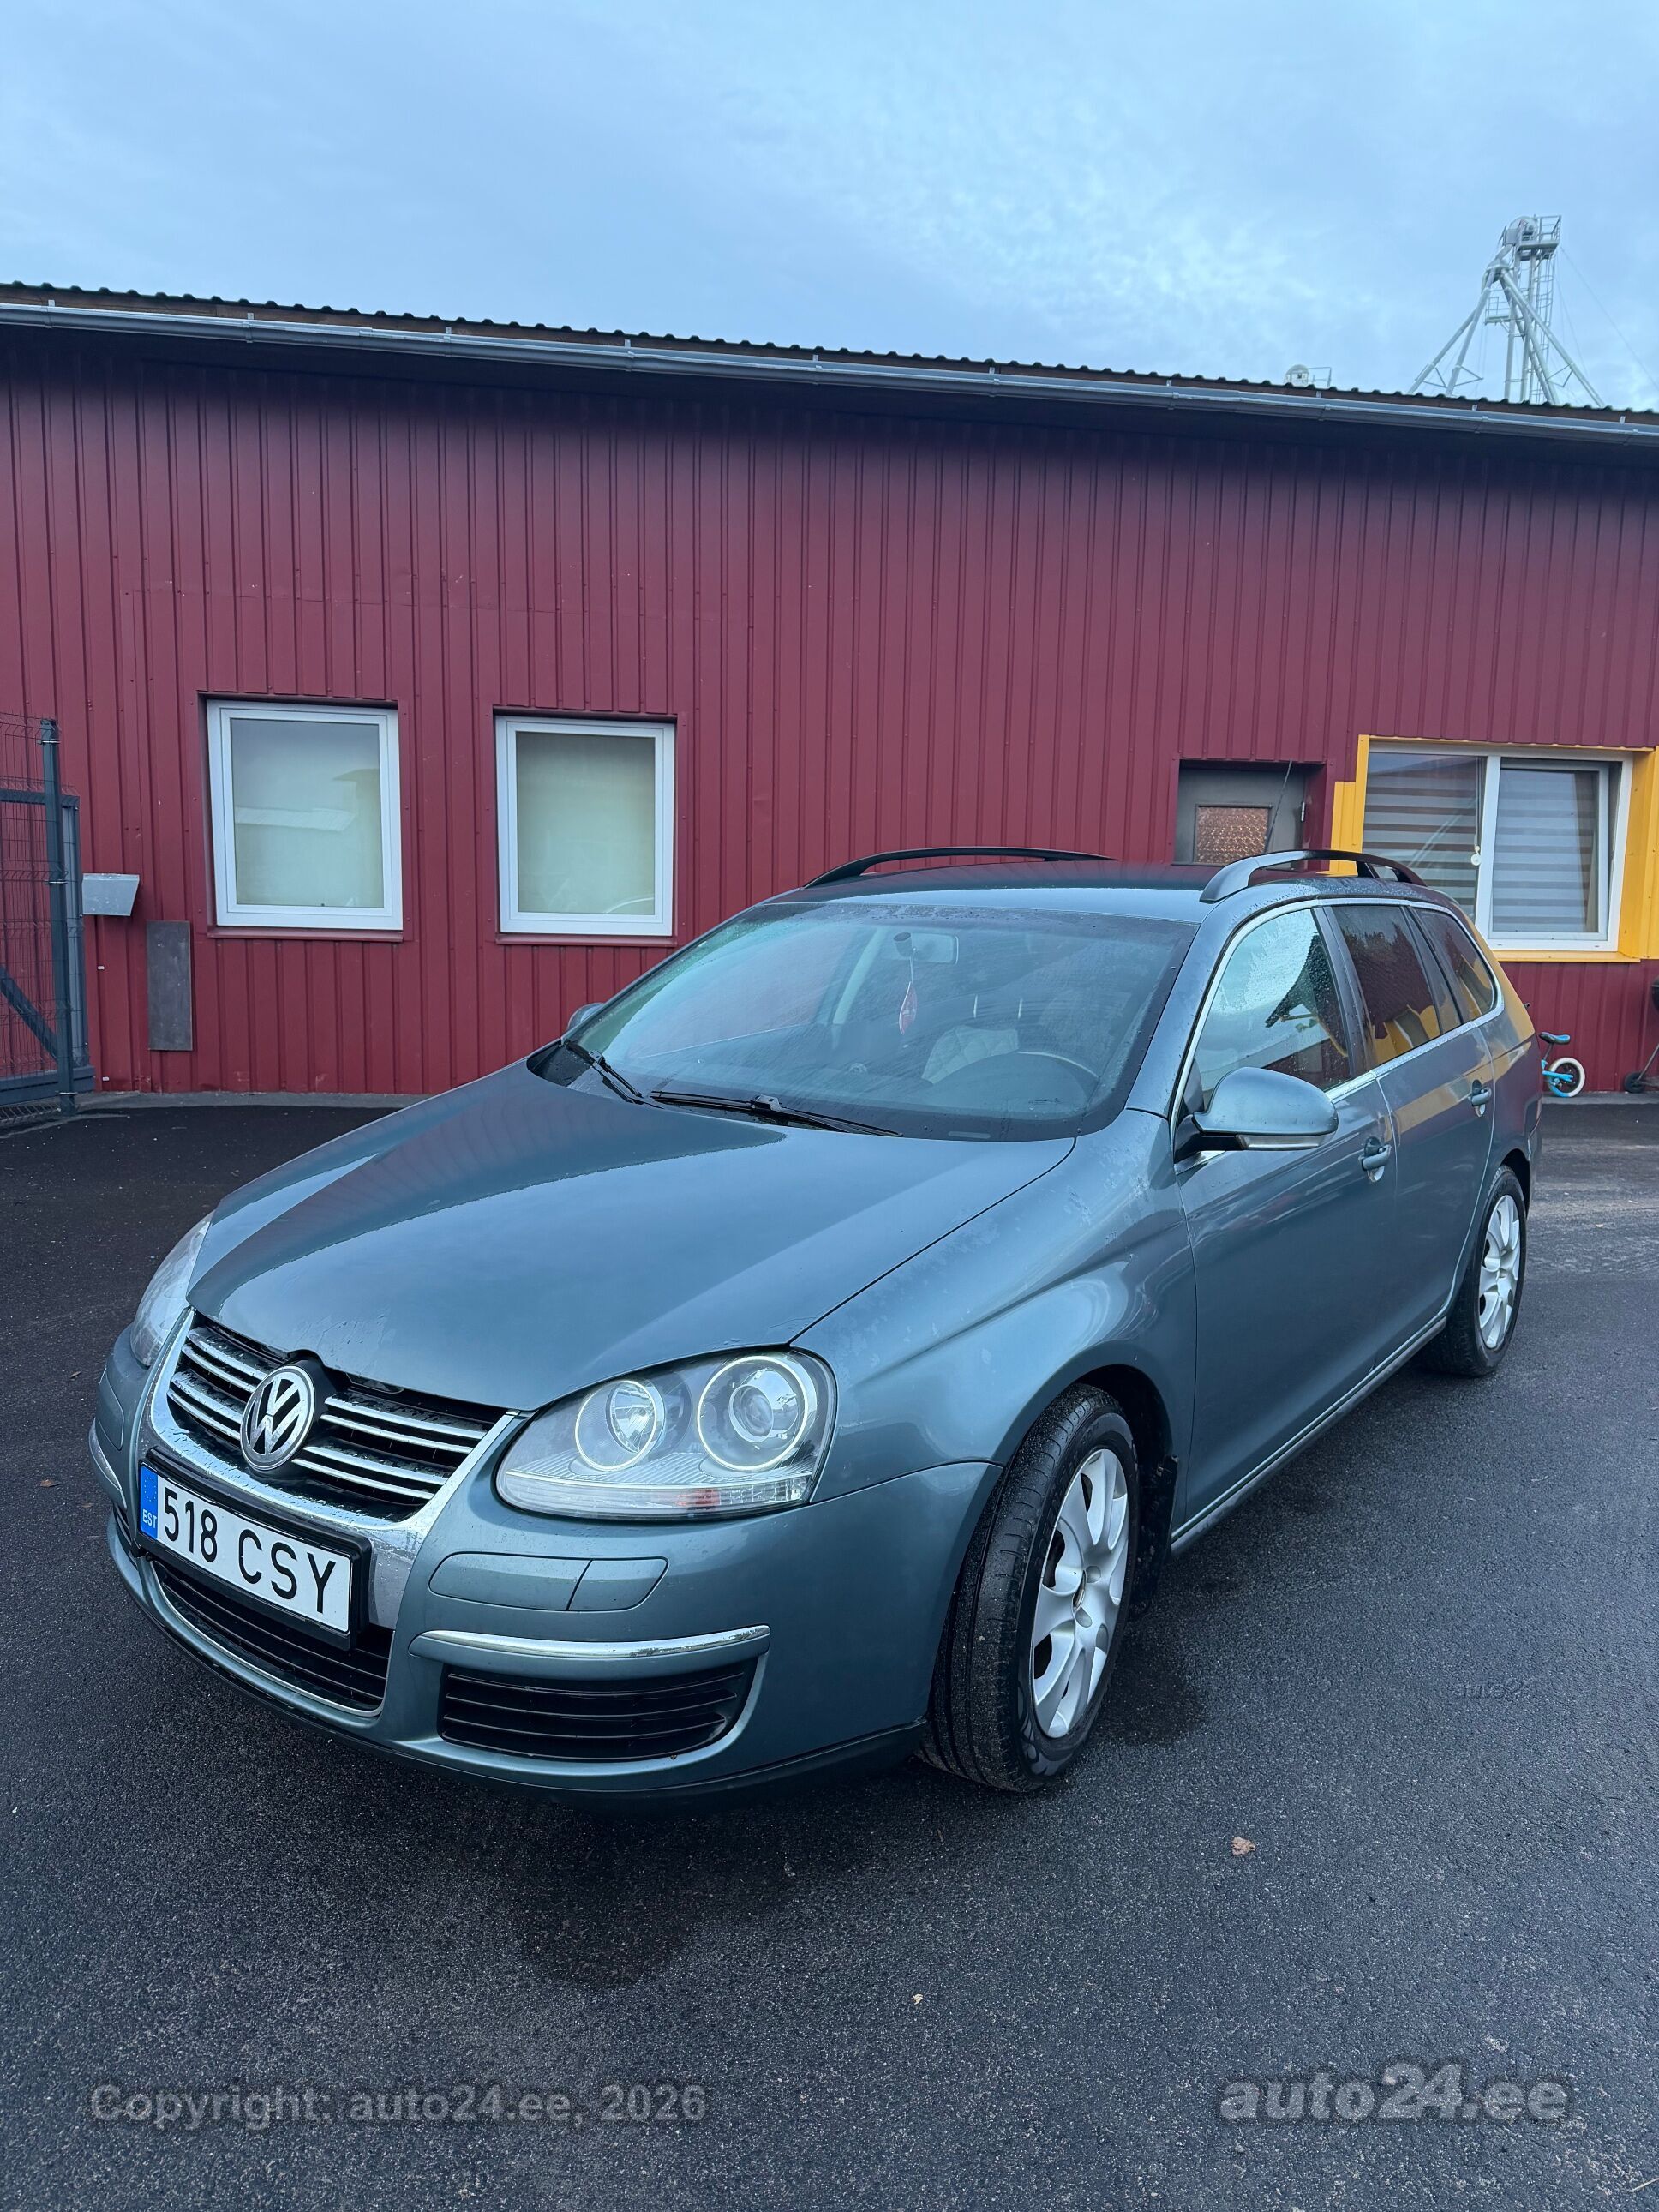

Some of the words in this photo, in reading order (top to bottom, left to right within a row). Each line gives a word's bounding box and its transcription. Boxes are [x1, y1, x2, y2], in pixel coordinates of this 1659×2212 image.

[243, 1373, 308, 1460] VW
[142, 1509, 158, 1529] EST
[164, 1485, 218, 1563] 518
[238, 1528, 337, 1615] CSY
